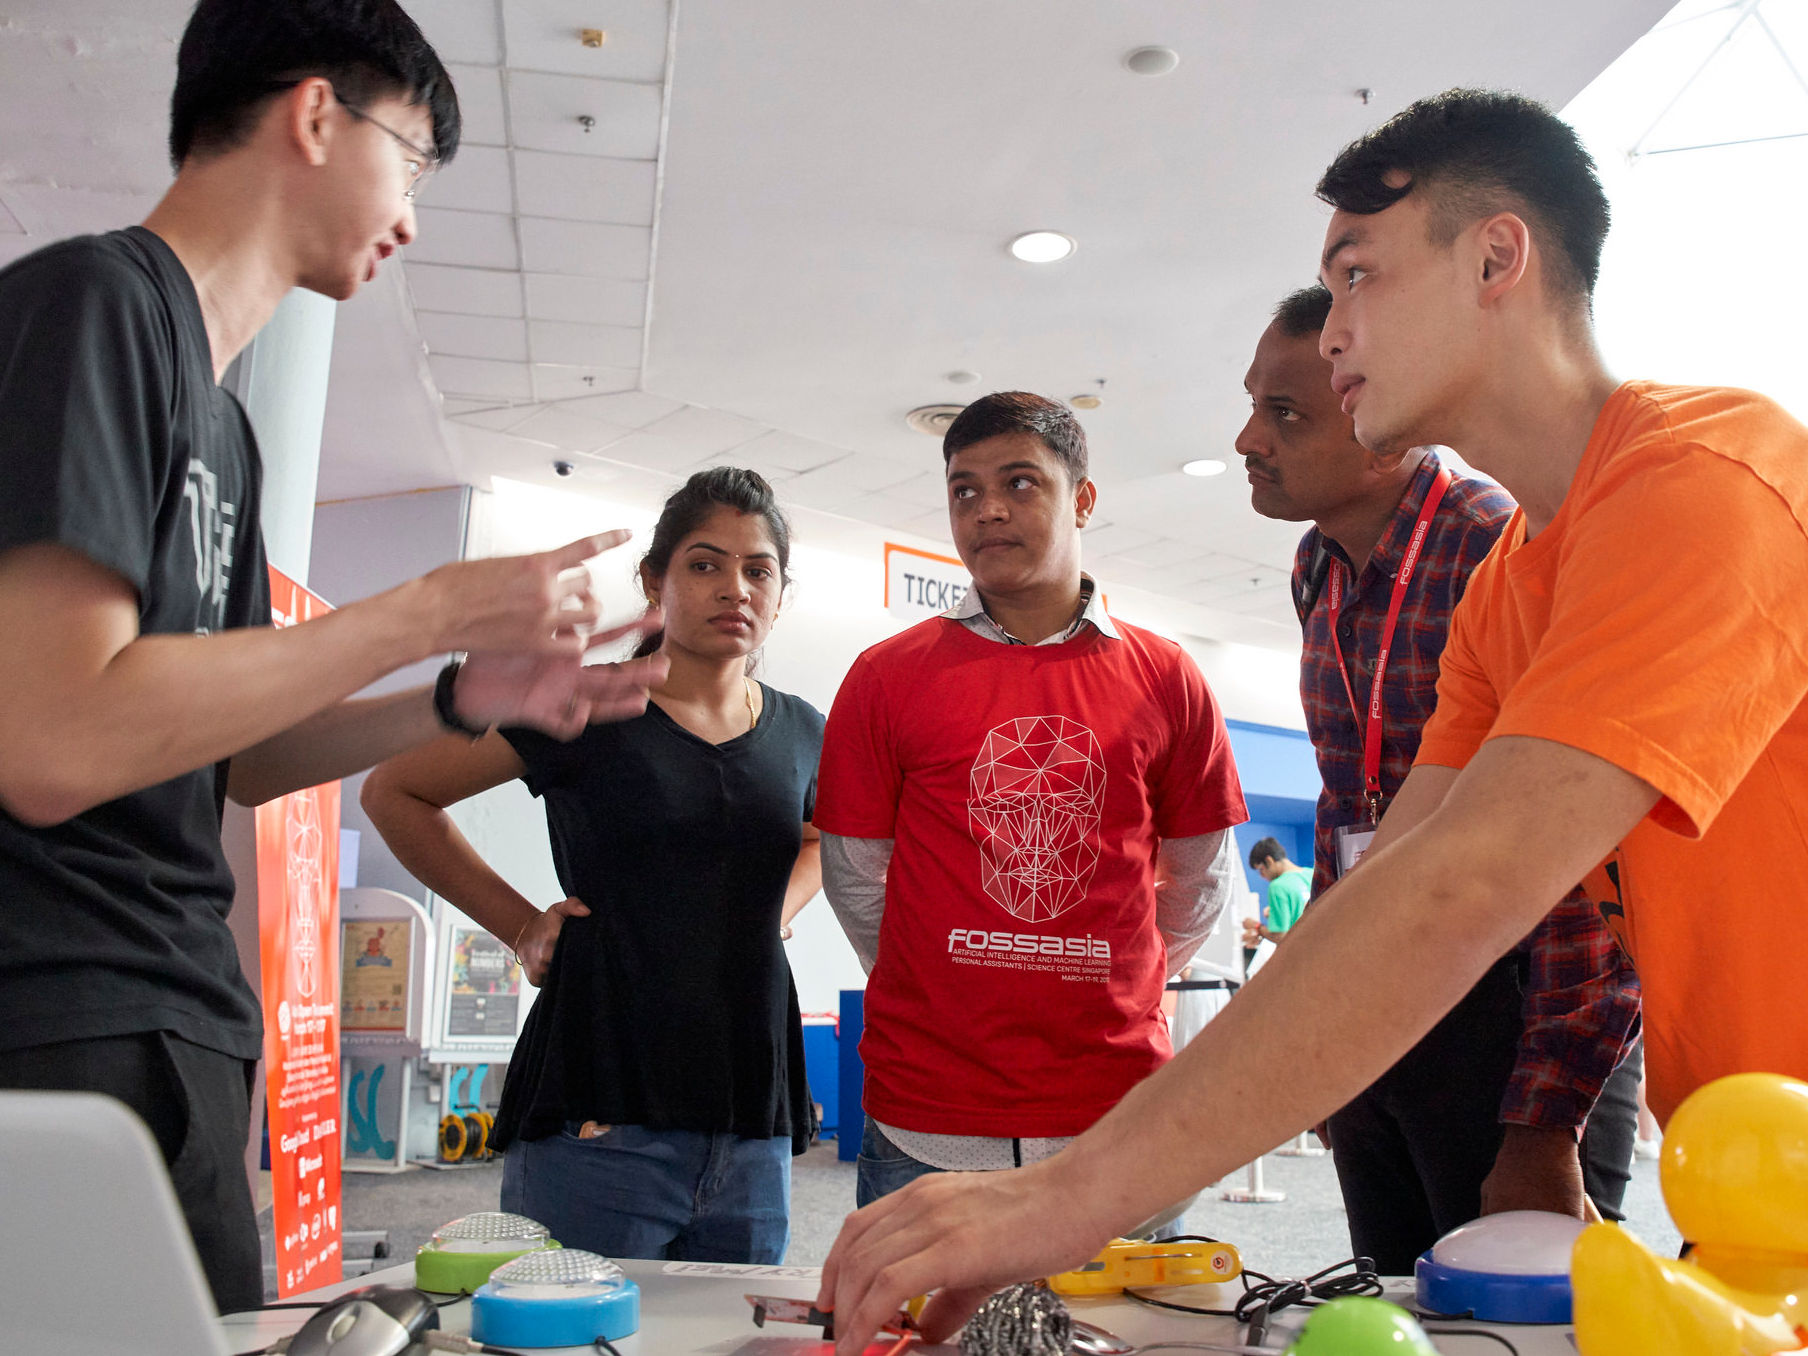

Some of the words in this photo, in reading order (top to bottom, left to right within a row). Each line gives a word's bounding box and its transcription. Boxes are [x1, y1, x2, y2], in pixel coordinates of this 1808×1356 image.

[1399, 520, 1428, 585] fossasia
[904, 573, 968, 610] TICKE
[1331, 561, 1341, 610] ossasia
[1371, 649, 1388, 719] fossasia
[947, 928, 1111, 959] fossasia
[952, 948, 986, 958] ARTIFICIAL
[986, 951, 1036, 963] INTELLIGENCE
[1037, 956, 1052, 964] AND
[1053, 957, 1083, 966] MACHINE
[1084, 959, 1111, 967] LEARNING
[951, 957, 982, 966] PERSONAL
[982, 960, 1023, 970] ASSISTANTS
[1027, 964, 1056, 972] SCIENCE
[1056, 966, 1081, 974] CENTRE
[1061, 974, 1084, 982] MARCH
